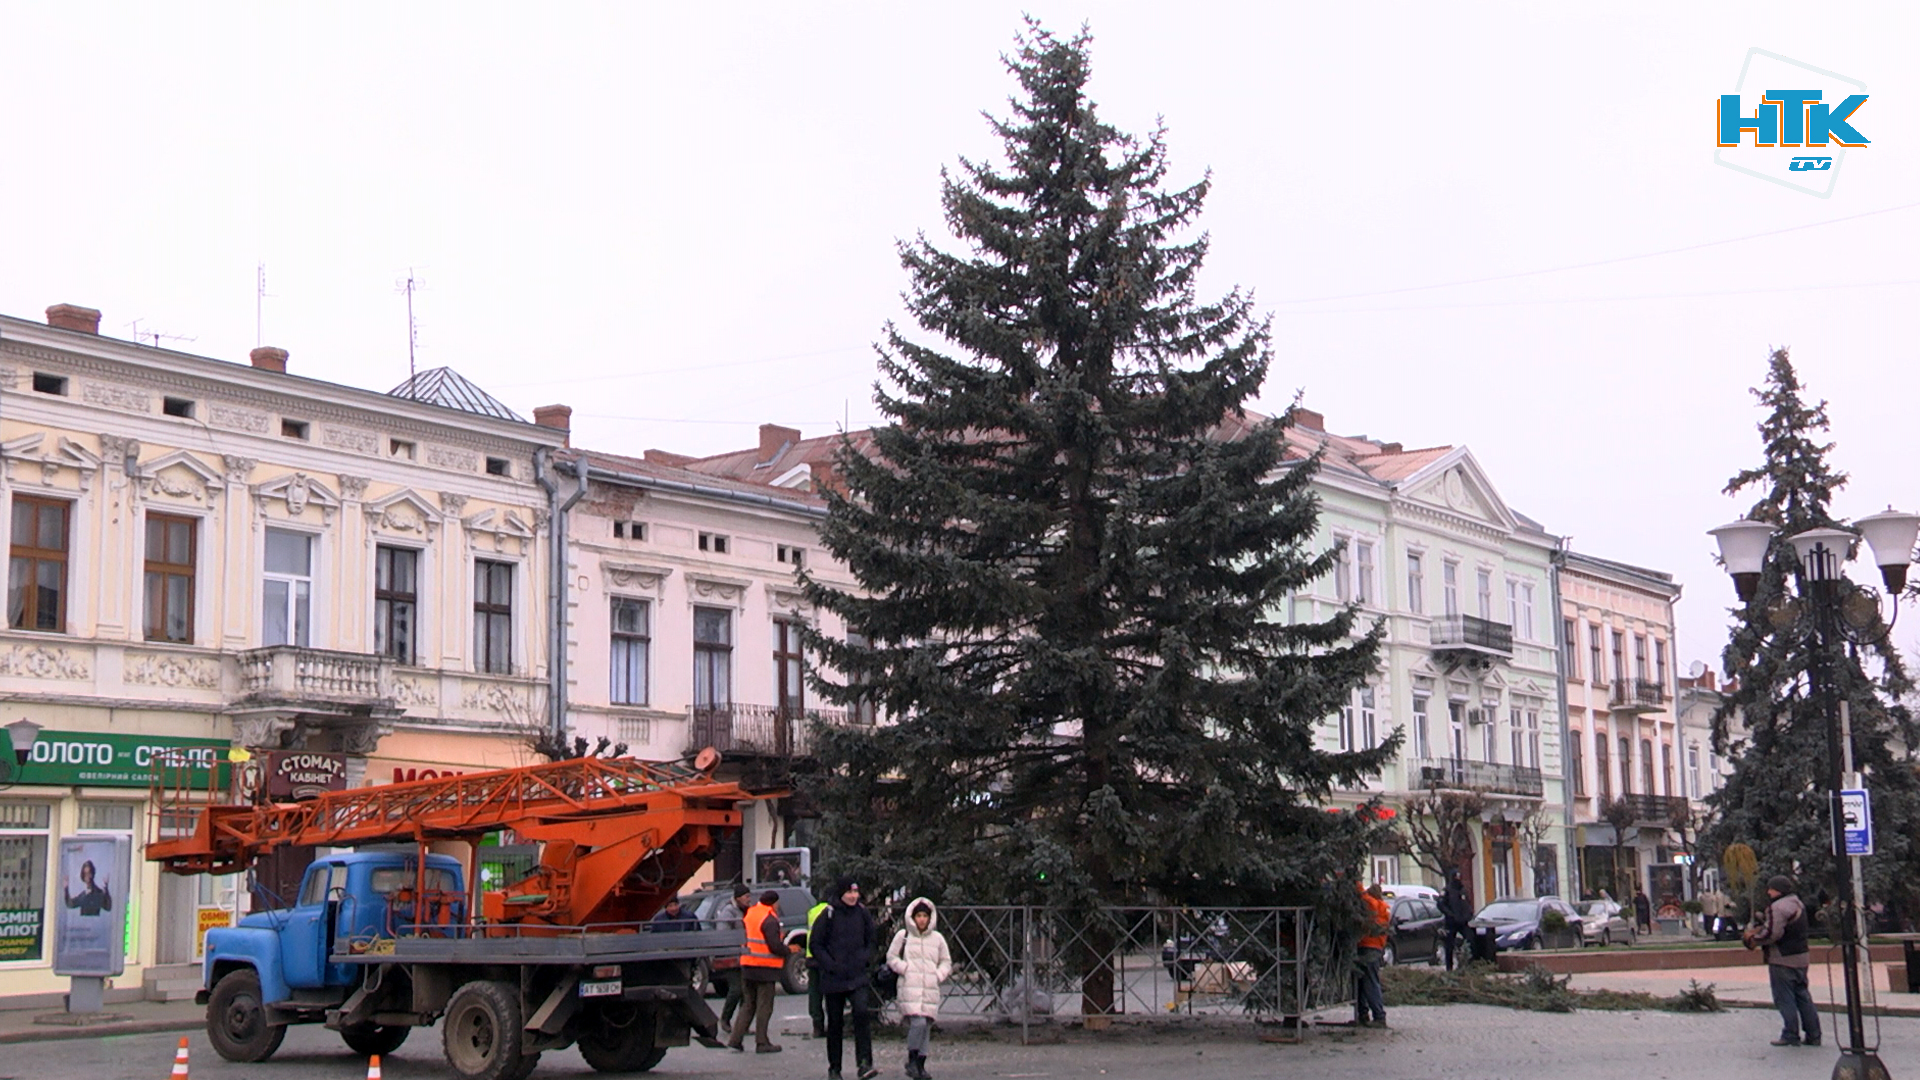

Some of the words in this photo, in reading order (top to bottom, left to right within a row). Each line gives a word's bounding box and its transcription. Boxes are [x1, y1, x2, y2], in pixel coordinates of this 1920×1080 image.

[27, 741, 113, 765] ОЛОТО
[282, 754, 342, 774] СТОМАТ
[290, 772, 333, 784] КАБІНЕТ
